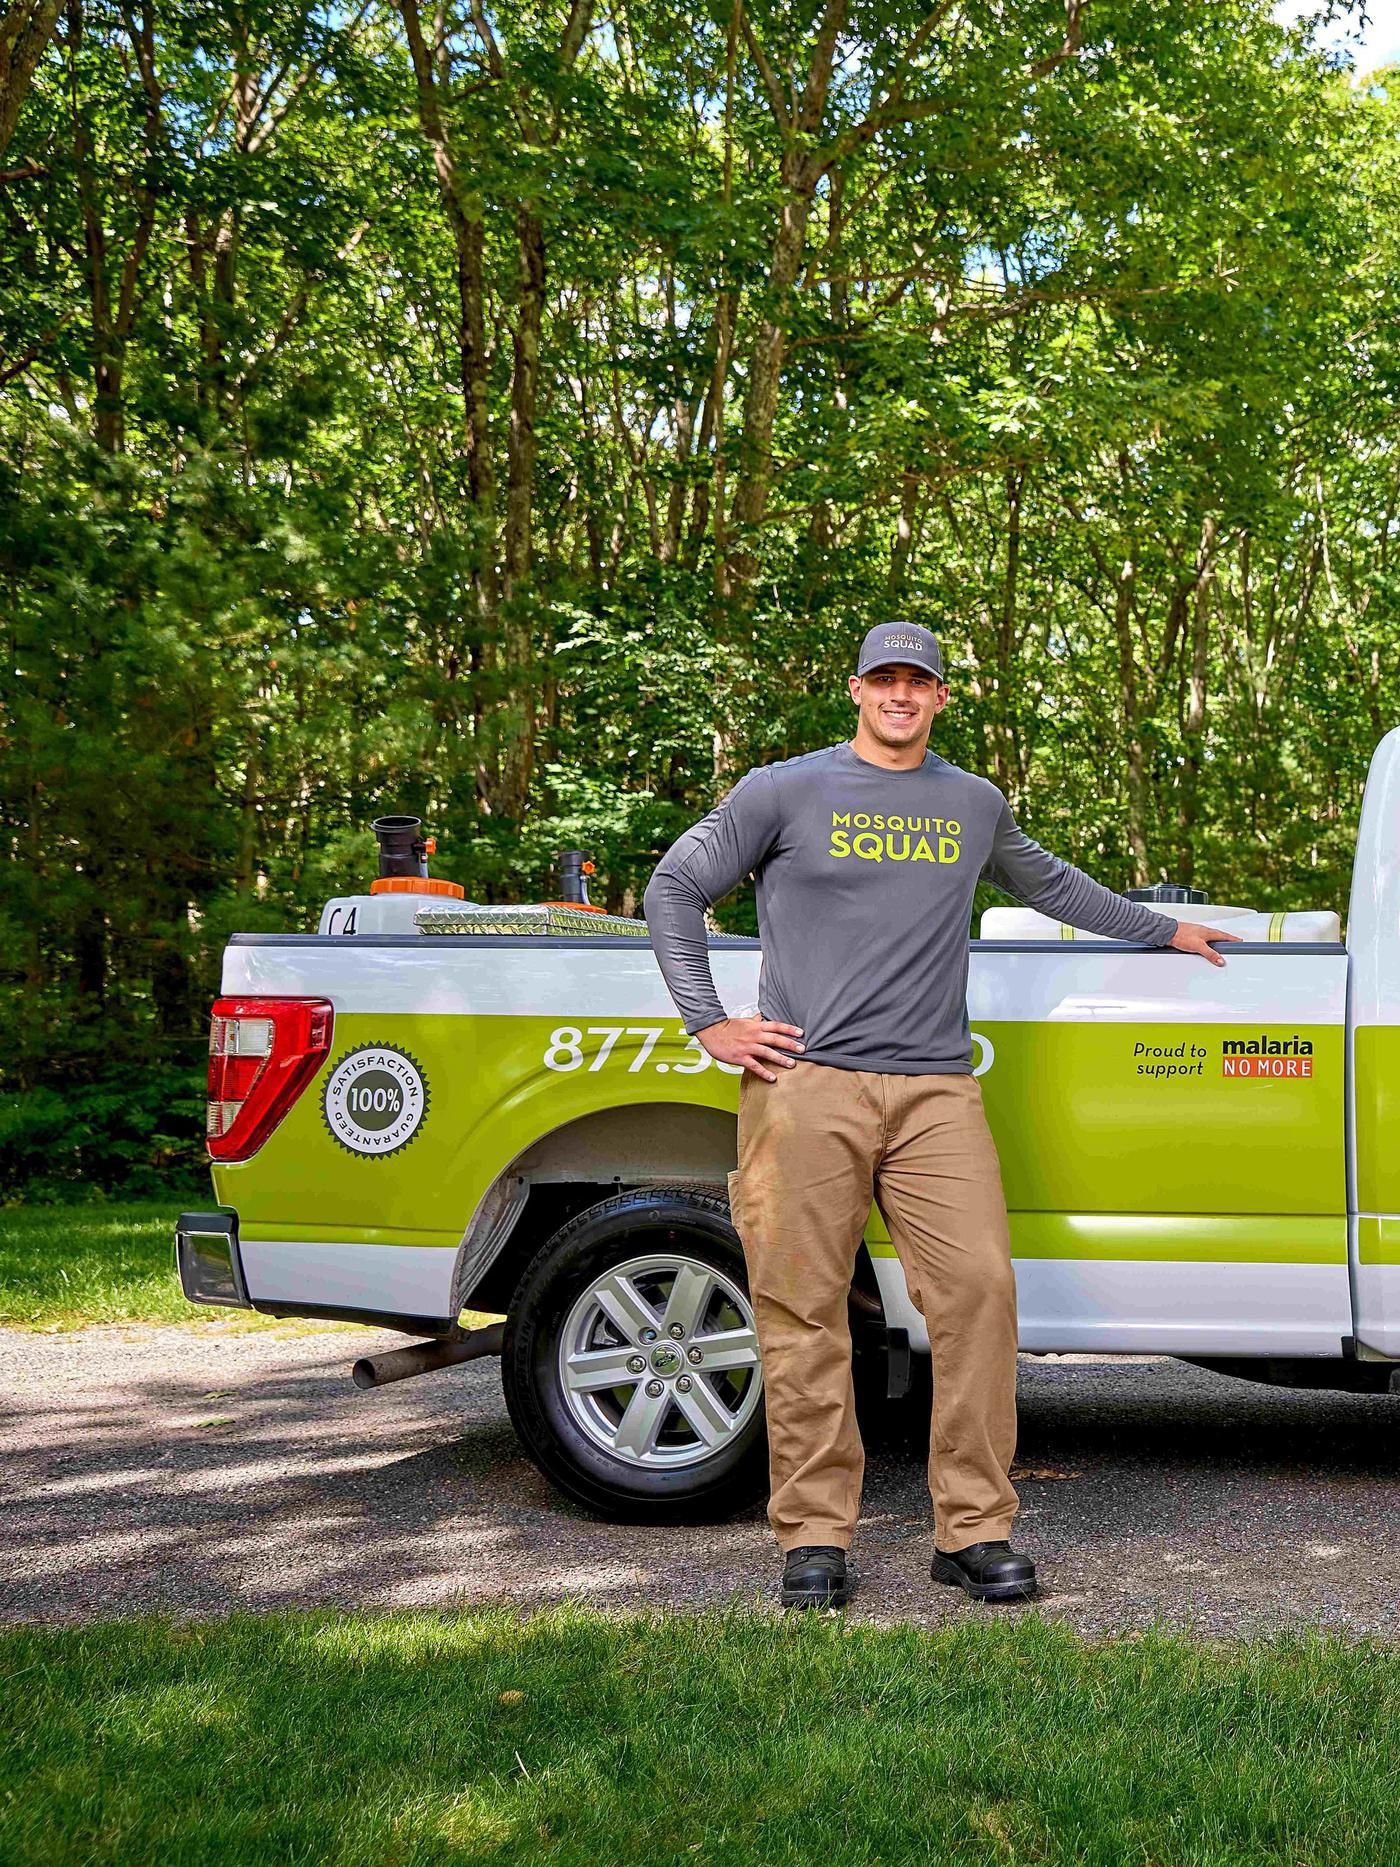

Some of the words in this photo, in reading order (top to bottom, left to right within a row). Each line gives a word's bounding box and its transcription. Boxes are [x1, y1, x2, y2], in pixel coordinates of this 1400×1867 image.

[883, 640, 923, 651] SQUAD
[884, 634, 923, 644] MOSQUITO
[832, 811, 962, 835] MOSQUITO
[1133, 1042, 1186, 1058] Proud
[1190, 1043, 1207, 1058] to
[1222, 1035, 1313, 1056] malaria
[332, 1056, 419, 1098] SATISFACTION
[1136, 1061, 1204, 1079] support
[1223, 1059, 1251, 1077] NO
[1257, 1059, 1312, 1078] MORE
[351, 1087, 401, 1113] 100%
[334, 1111, 415, 1146] GUARANTEED
